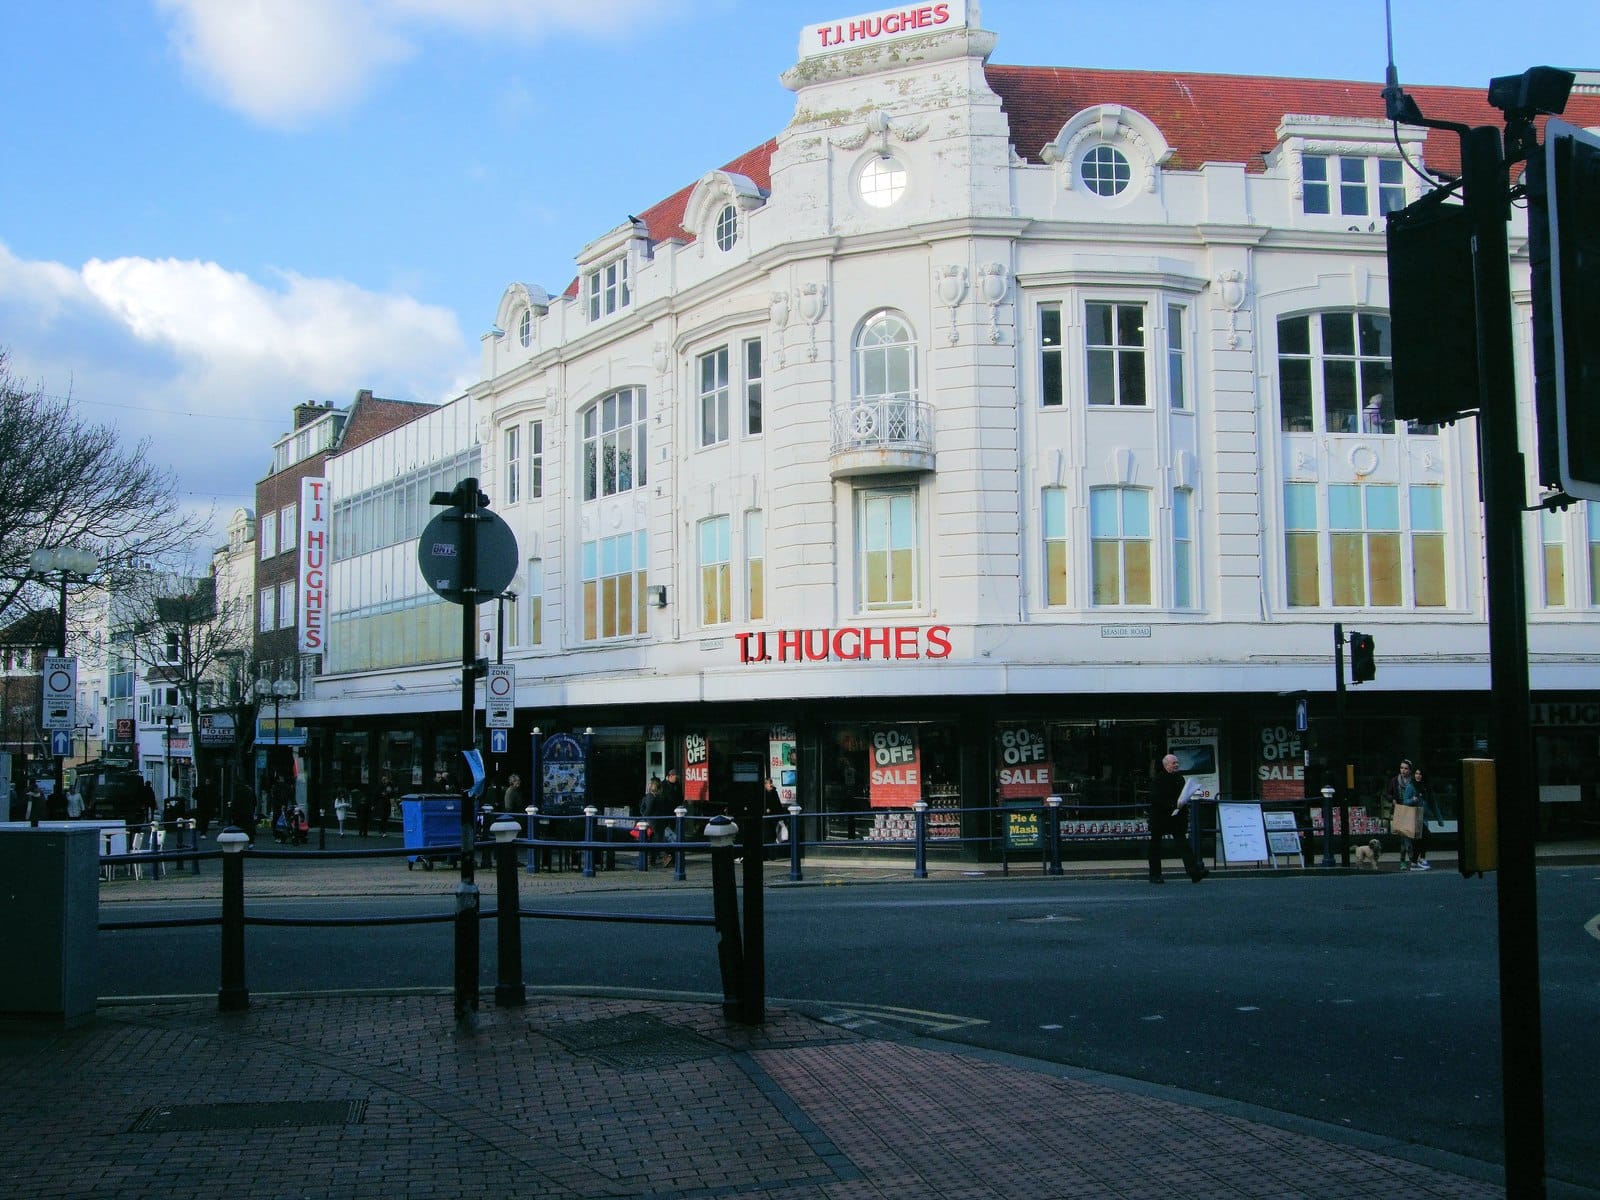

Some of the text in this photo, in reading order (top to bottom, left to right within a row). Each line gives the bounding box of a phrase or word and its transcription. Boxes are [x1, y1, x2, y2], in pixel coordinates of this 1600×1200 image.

[818, 3, 950, 47] T.J. HUGHES
[306, 531, 323, 648] HUGHES
[735, 626, 952, 664] T.J. HUGHES
[685, 734, 706, 749] 60%
[873, 730, 912, 749] 60%
[1002, 728, 1042, 747] 60%
[1261, 726, 1300, 743] 60%
[687, 745, 706, 764] OFF
[875, 745, 914, 765] OFF
[1004, 743, 1046, 764] OFF
[1263, 741, 1301, 760] OFF
[685, 768, 709, 780] SALE
[872, 770, 918, 785] SALE
[1000, 769, 1049, 784] SALE
[1258, 765, 1304, 780] SALE
[1010, 813, 1037, 822] Pie &
[1010, 824, 1038, 834] Mash
